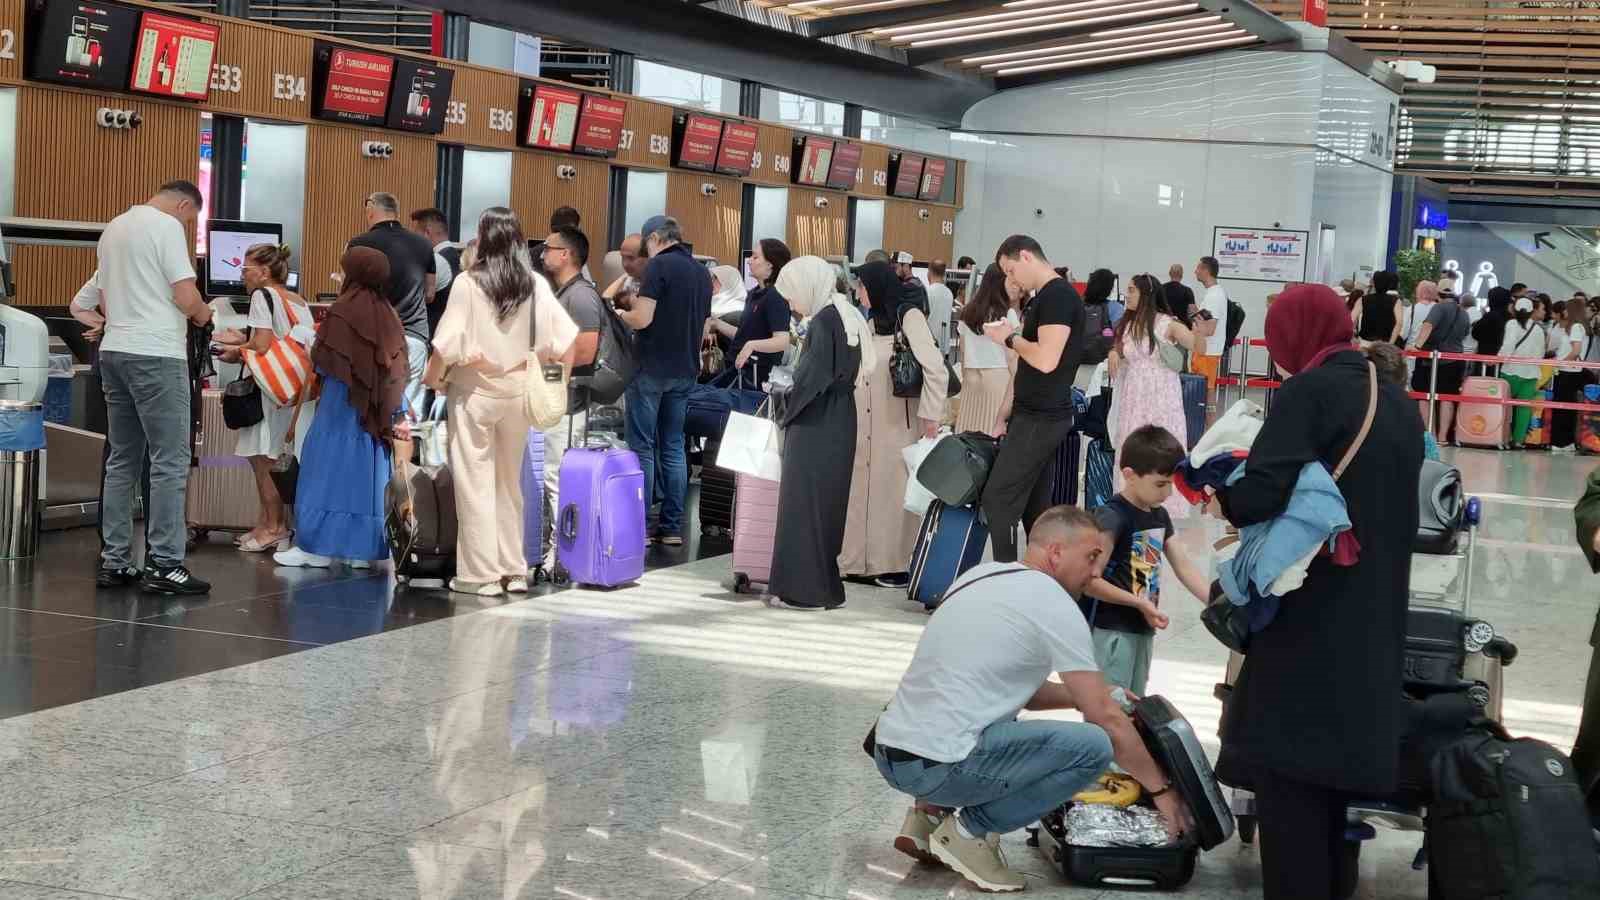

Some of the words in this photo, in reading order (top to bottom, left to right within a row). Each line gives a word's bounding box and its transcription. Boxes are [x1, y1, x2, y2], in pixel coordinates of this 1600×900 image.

[273, 73, 306, 102] E34
[444, 100, 467, 124] 35
[489, 107, 513, 132] E36
[618, 128, 634, 150] 37
[650, 133, 668, 155] E38
[774, 154, 790, 174] E40
[873, 169, 887, 187] E42
[942, 219, 953, 236] E43
